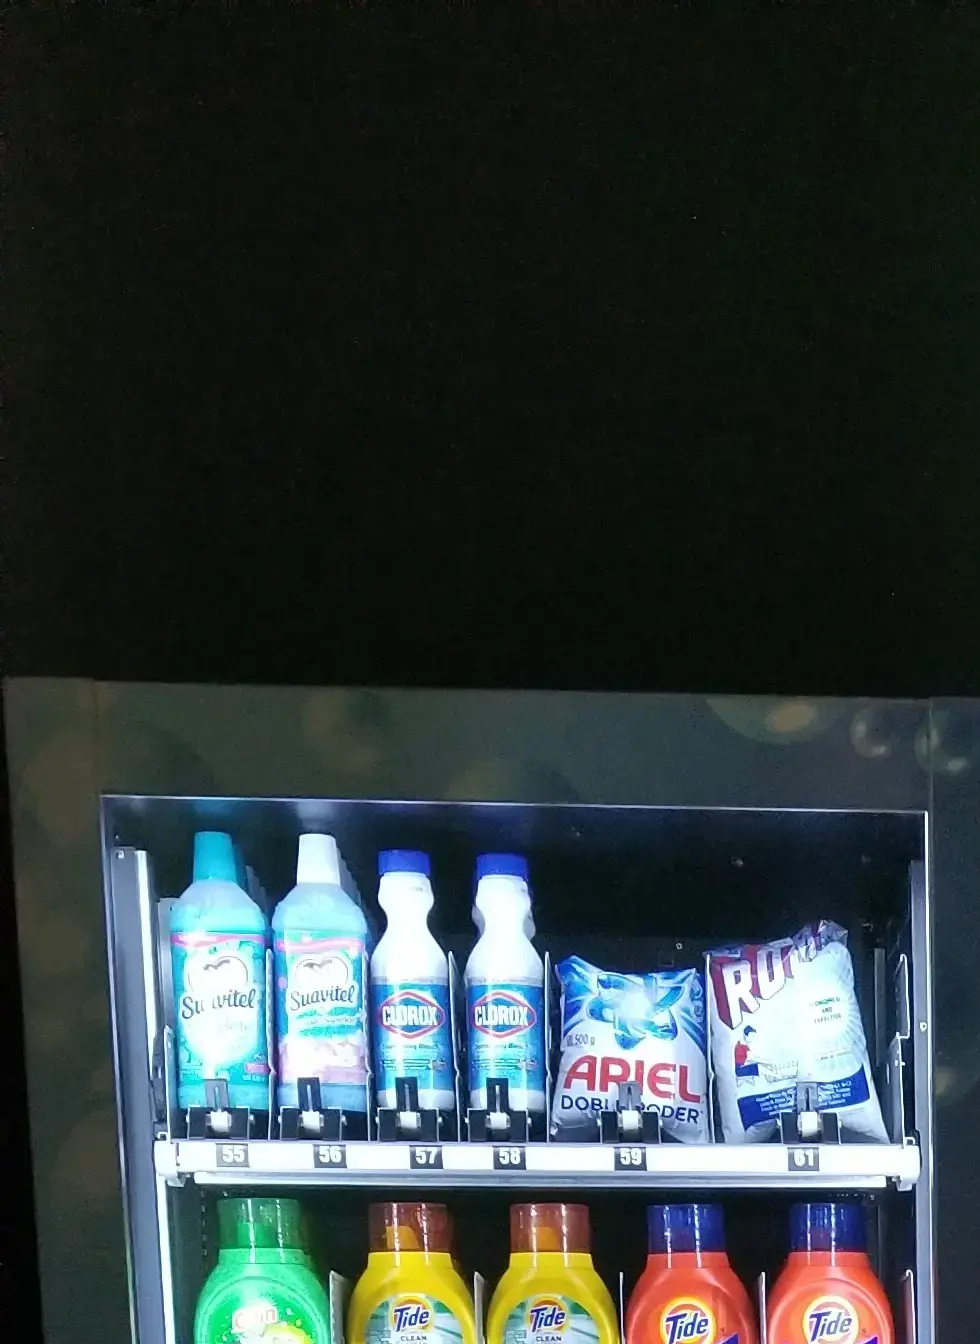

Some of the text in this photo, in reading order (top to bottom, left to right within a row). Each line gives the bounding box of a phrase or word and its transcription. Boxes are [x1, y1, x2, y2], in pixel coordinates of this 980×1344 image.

[290, 985, 355, 1012] Suavitel
[382, 1005, 438, 1026] CLOROX
[474, 1005, 529, 1026] CLOROX
[563, 1055, 701, 1104] ARIEL
[222, 1147, 245, 1163] 55
[318, 1147, 342, 1163] 56
[415, 1148, 438, 1164] 57
[498, 1148, 520, 1164] 58
[619, 1149, 642, 1166] 59
[792, 1149, 815, 1166] 61
[234, 1308, 276, 1330] Gin
[394, 1306, 430, 1332] Tide
[530, 1306, 566, 1332] Tide
[807, 1309, 853, 1344] Tide
